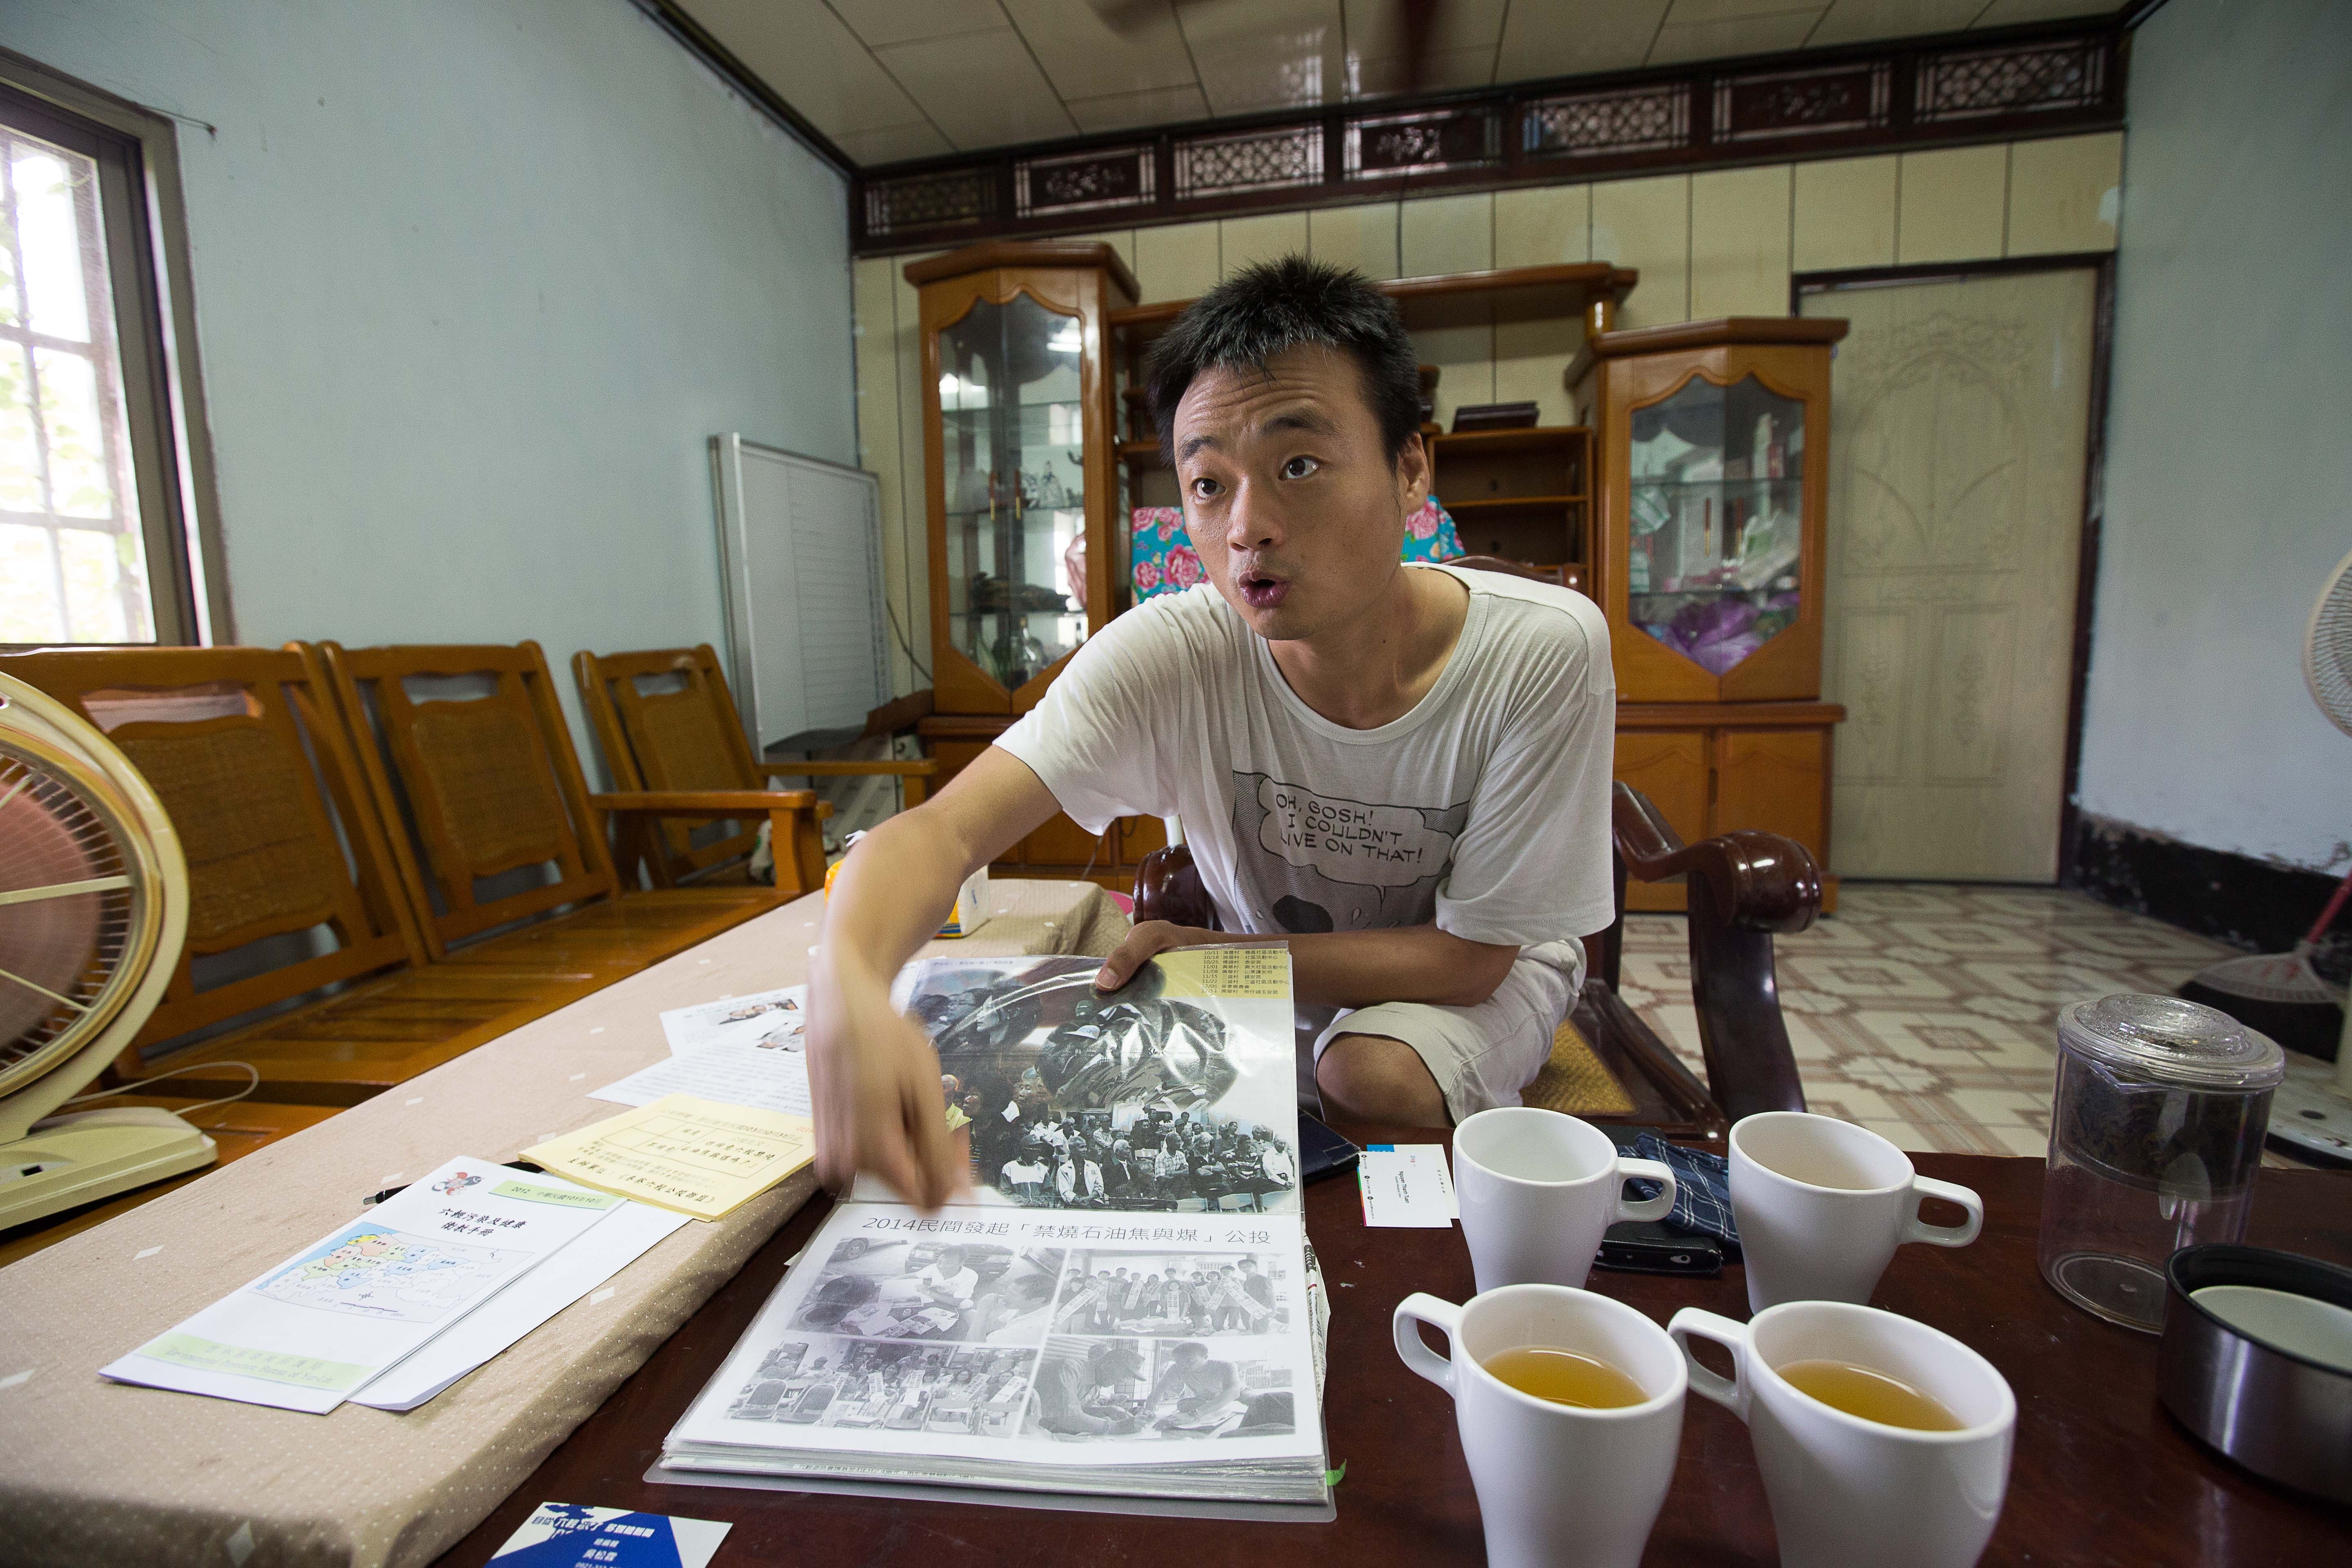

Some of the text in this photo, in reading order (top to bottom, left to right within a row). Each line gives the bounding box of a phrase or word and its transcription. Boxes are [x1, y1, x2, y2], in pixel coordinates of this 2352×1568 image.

[1276, 793, 1374, 826] OH, GOSH!
[1288, 813, 1403, 844] I COULDN'T
[1281, 829, 1422, 863] LIVE ON THAT!
